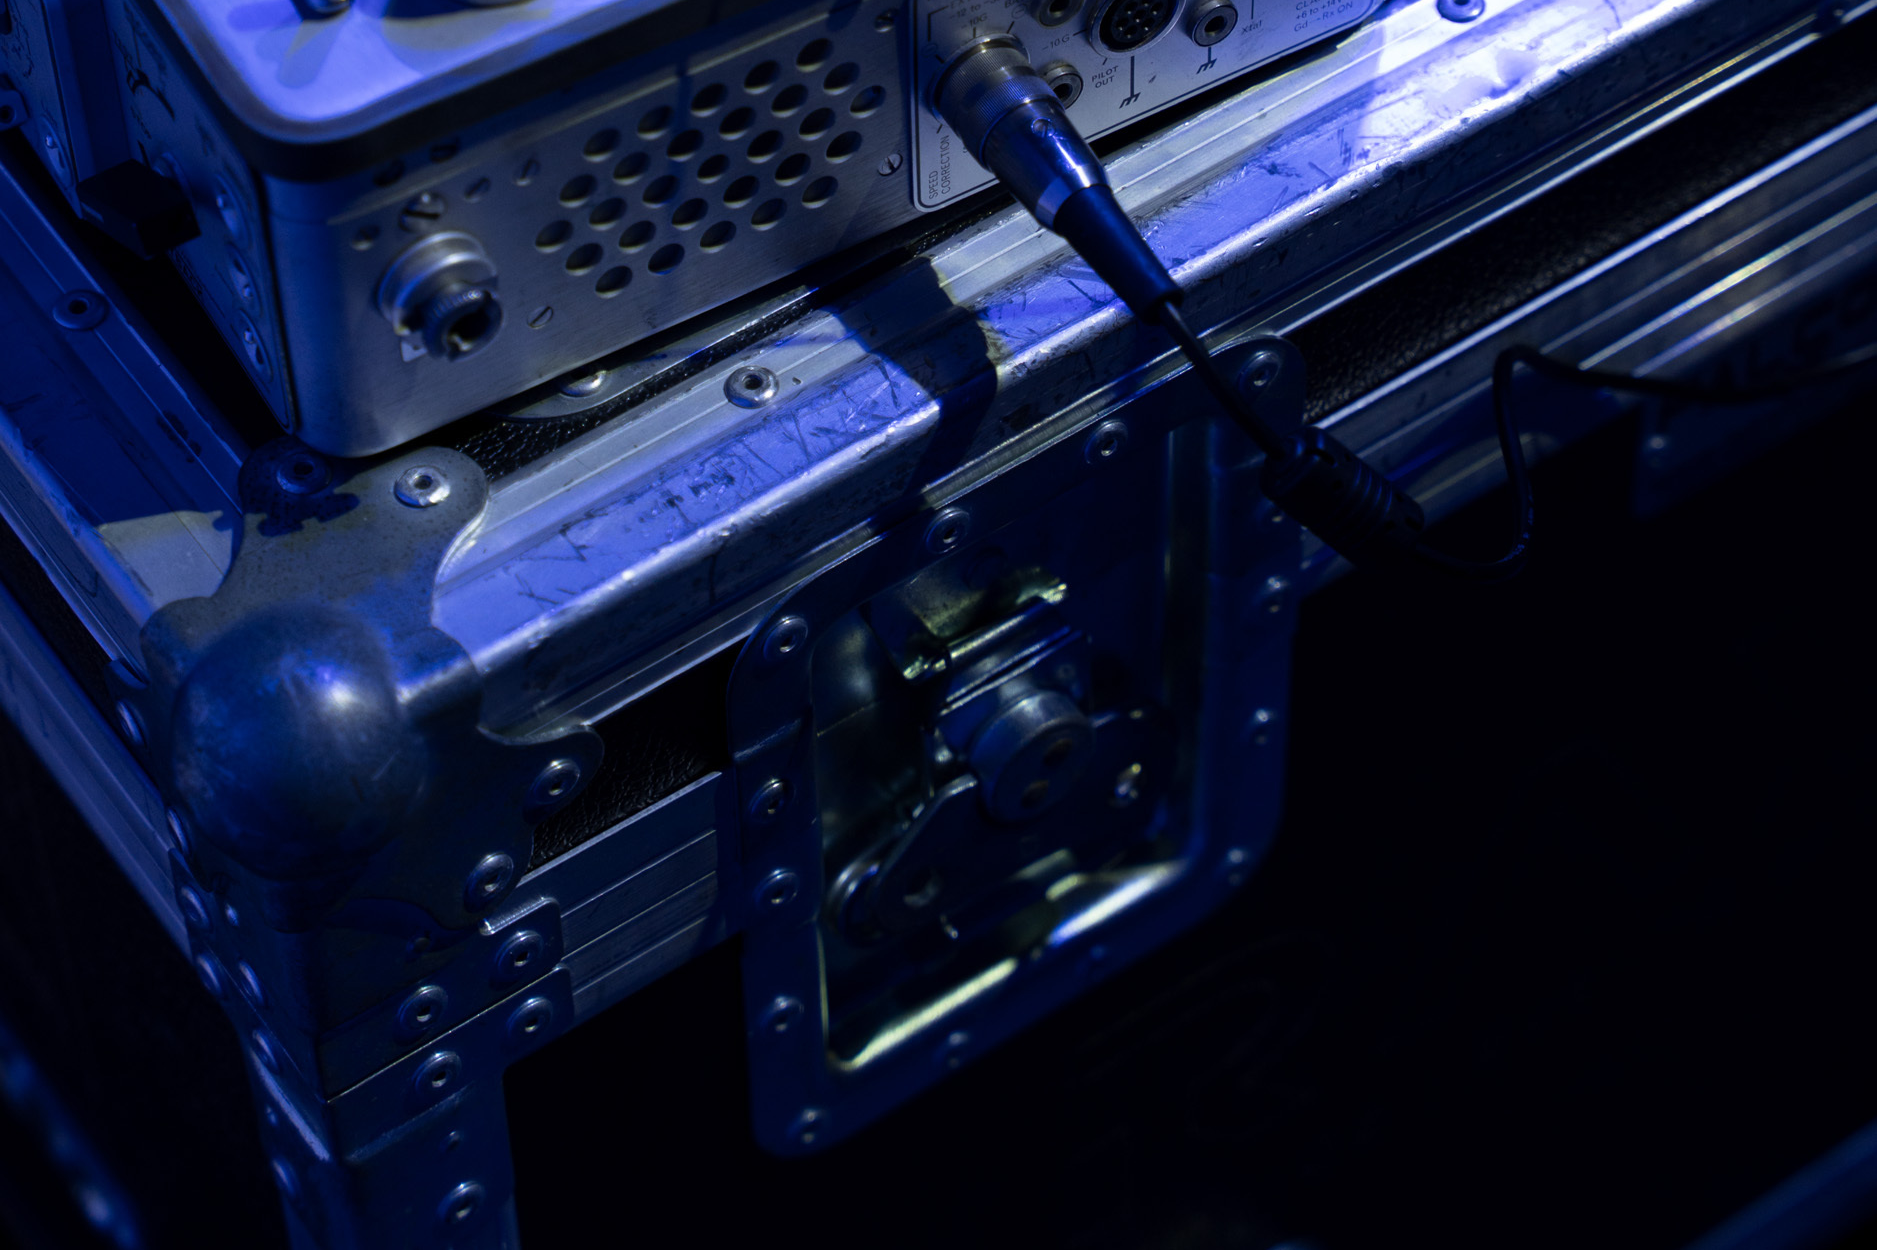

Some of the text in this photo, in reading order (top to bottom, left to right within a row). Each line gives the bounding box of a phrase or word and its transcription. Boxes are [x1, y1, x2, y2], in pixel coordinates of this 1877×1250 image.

[970, 3, 982, 13] to
[1294, 0, 1354, 33] Gd Rx ON
[1295, 10, 1308, 20] +6
[1309, 6, 1319, 16] to
[1091, 65, 1119, 83] PILOT
[1094, 74, 1116, 90] OUT
[939, 134, 952, 195] CORRECTION
[928, 169, 939, 200] SPEED
